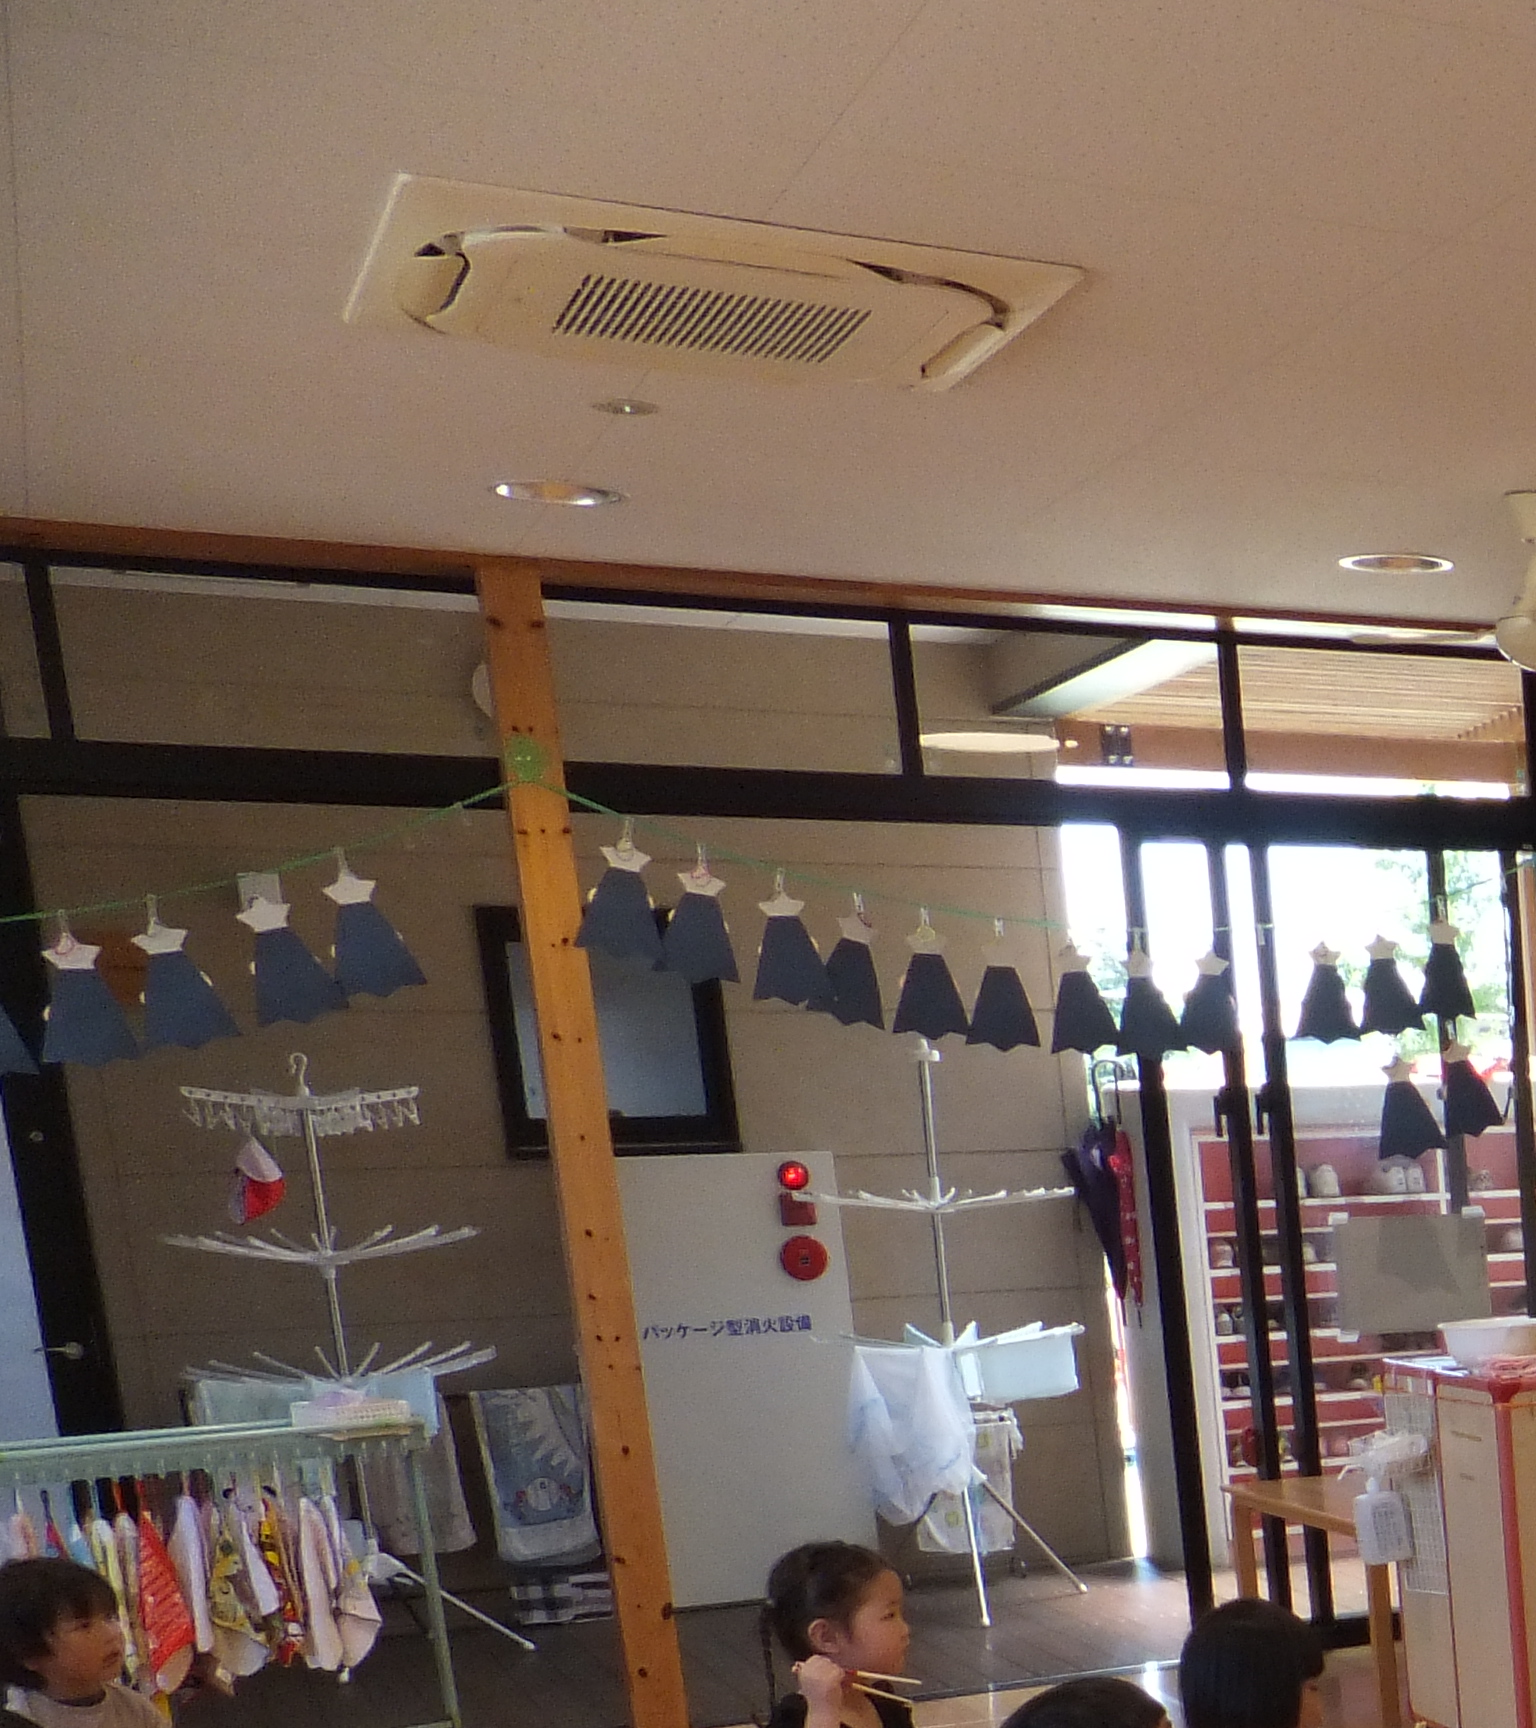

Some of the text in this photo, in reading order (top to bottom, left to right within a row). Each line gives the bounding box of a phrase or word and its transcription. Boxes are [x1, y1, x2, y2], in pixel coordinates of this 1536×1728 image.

[642, 1314, 812, 1340] パッケージ型消火設備
